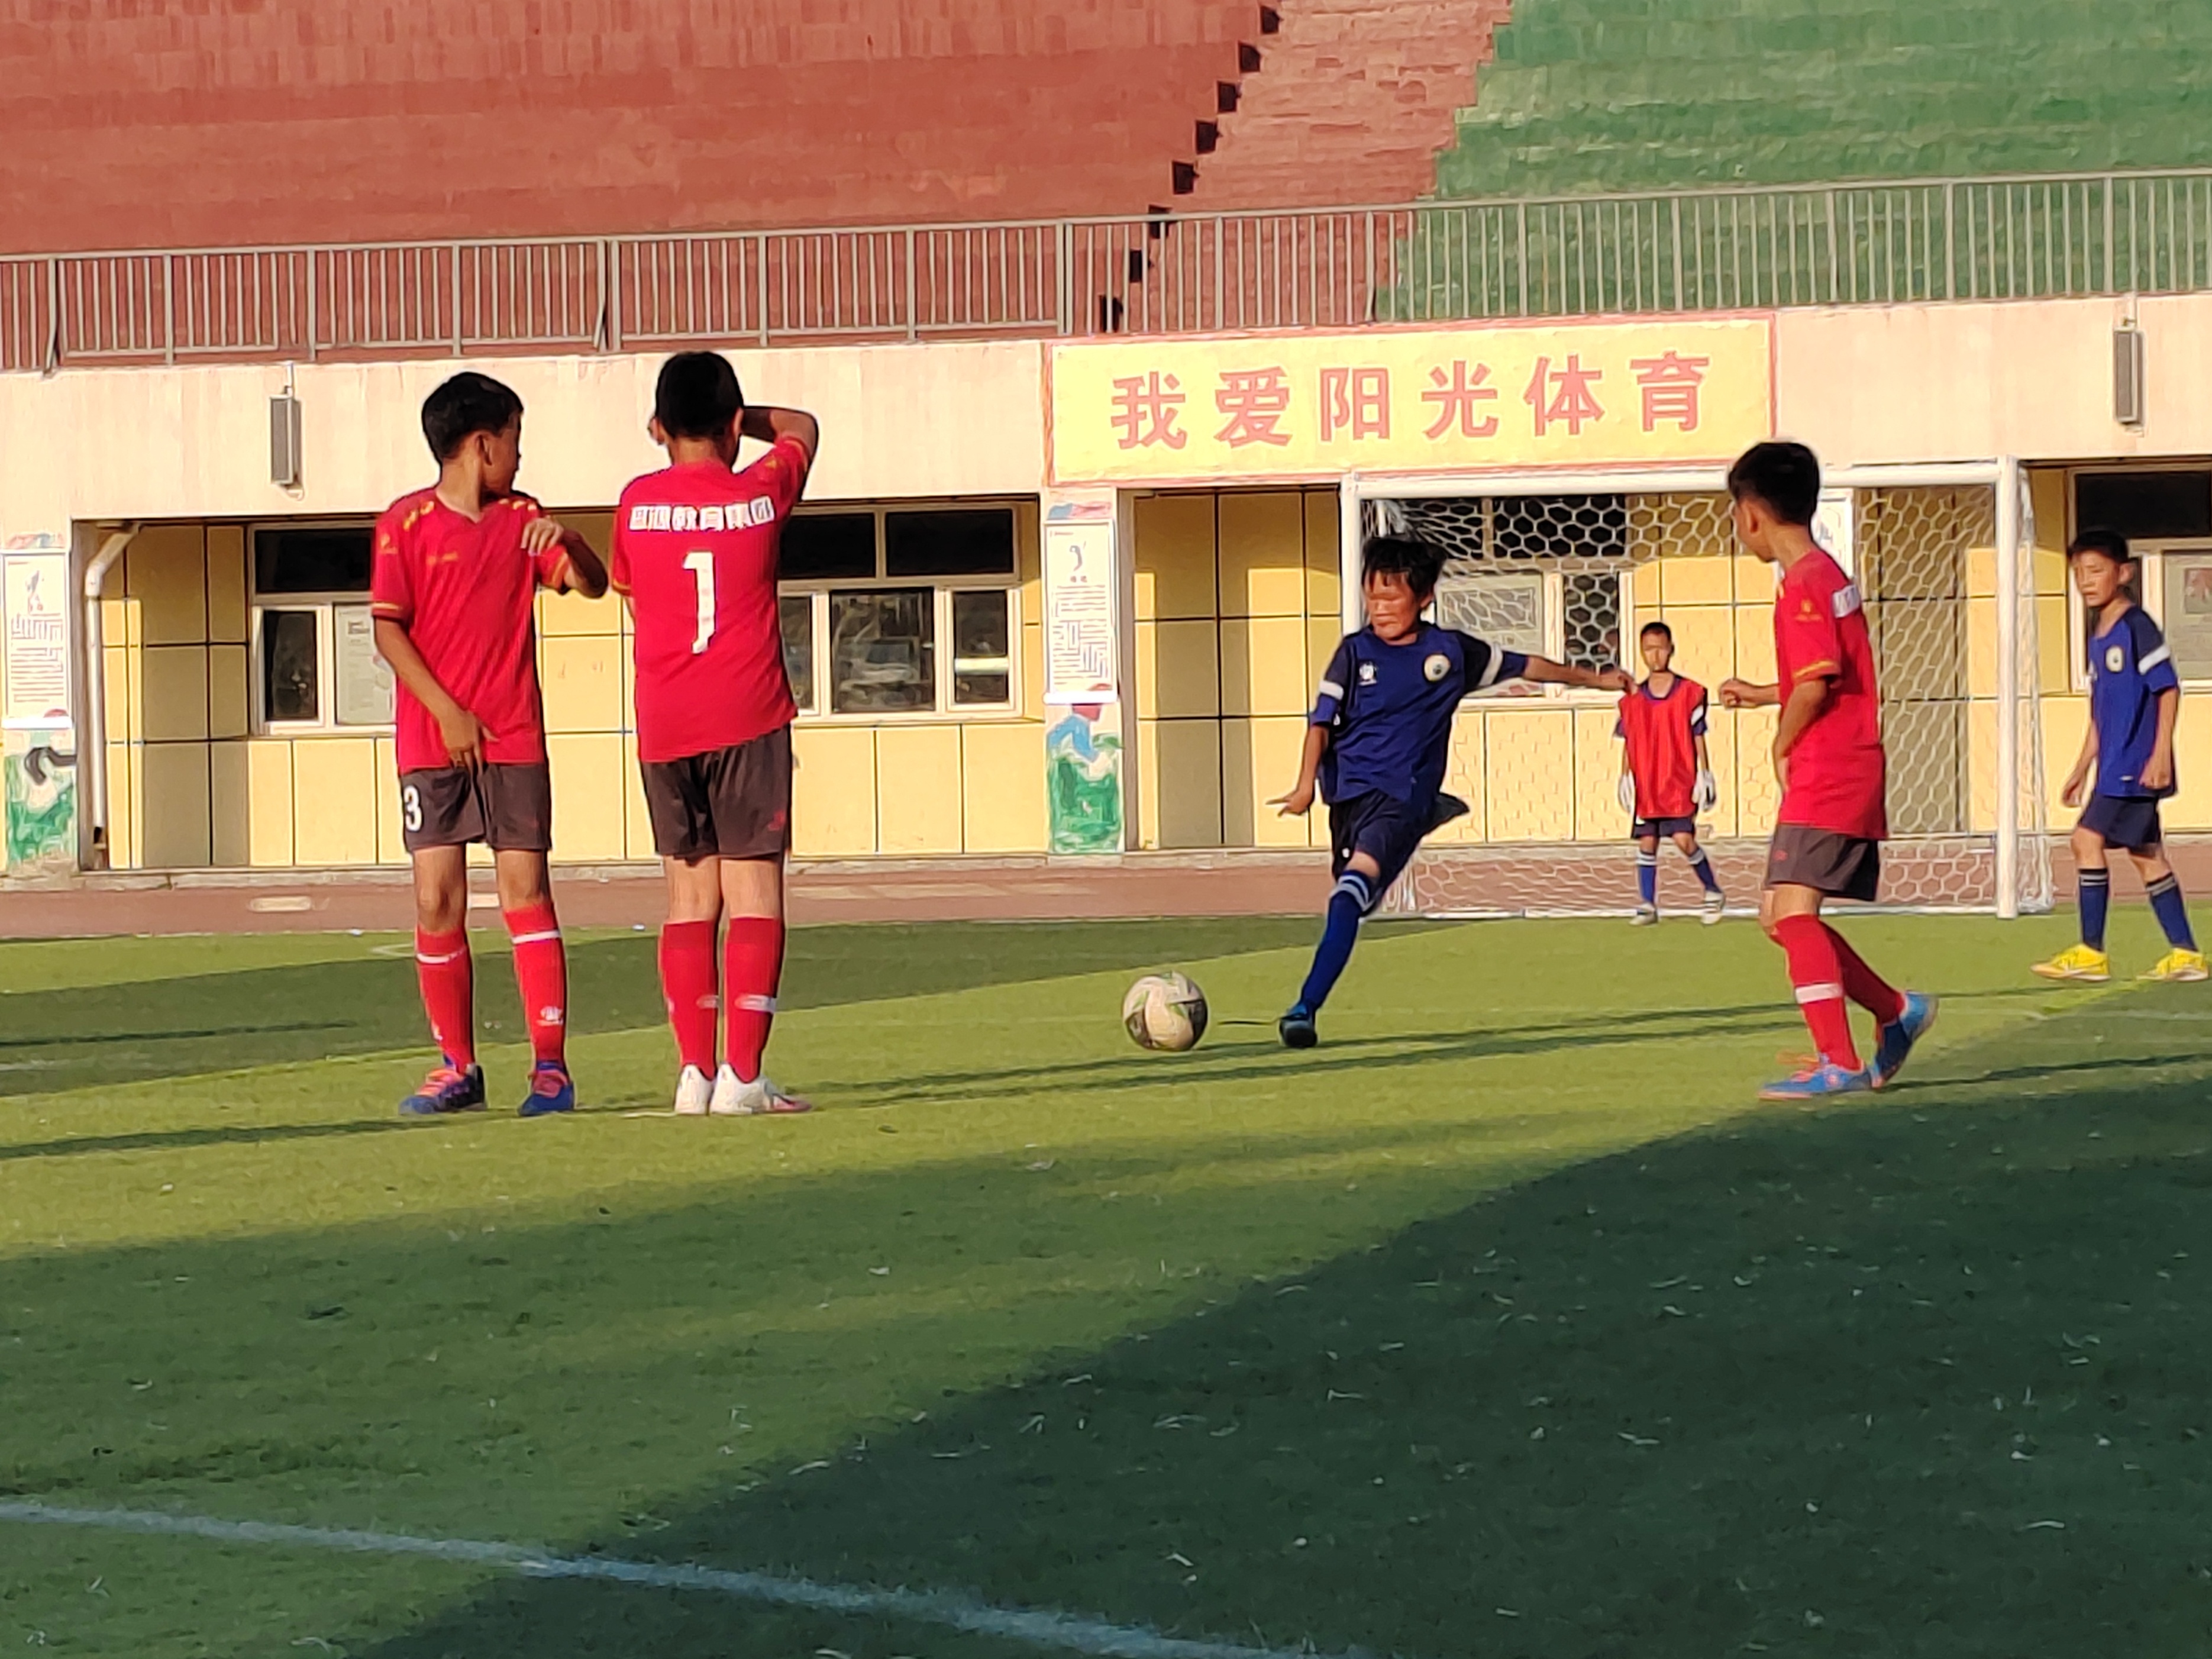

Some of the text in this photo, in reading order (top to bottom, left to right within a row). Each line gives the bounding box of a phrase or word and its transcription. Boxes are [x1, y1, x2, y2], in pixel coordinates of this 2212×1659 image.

[1110, 350, 1710, 449] 我爱阳光体育
[682, 551, 715, 654] 1
[403, 786, 422, 831] 3
